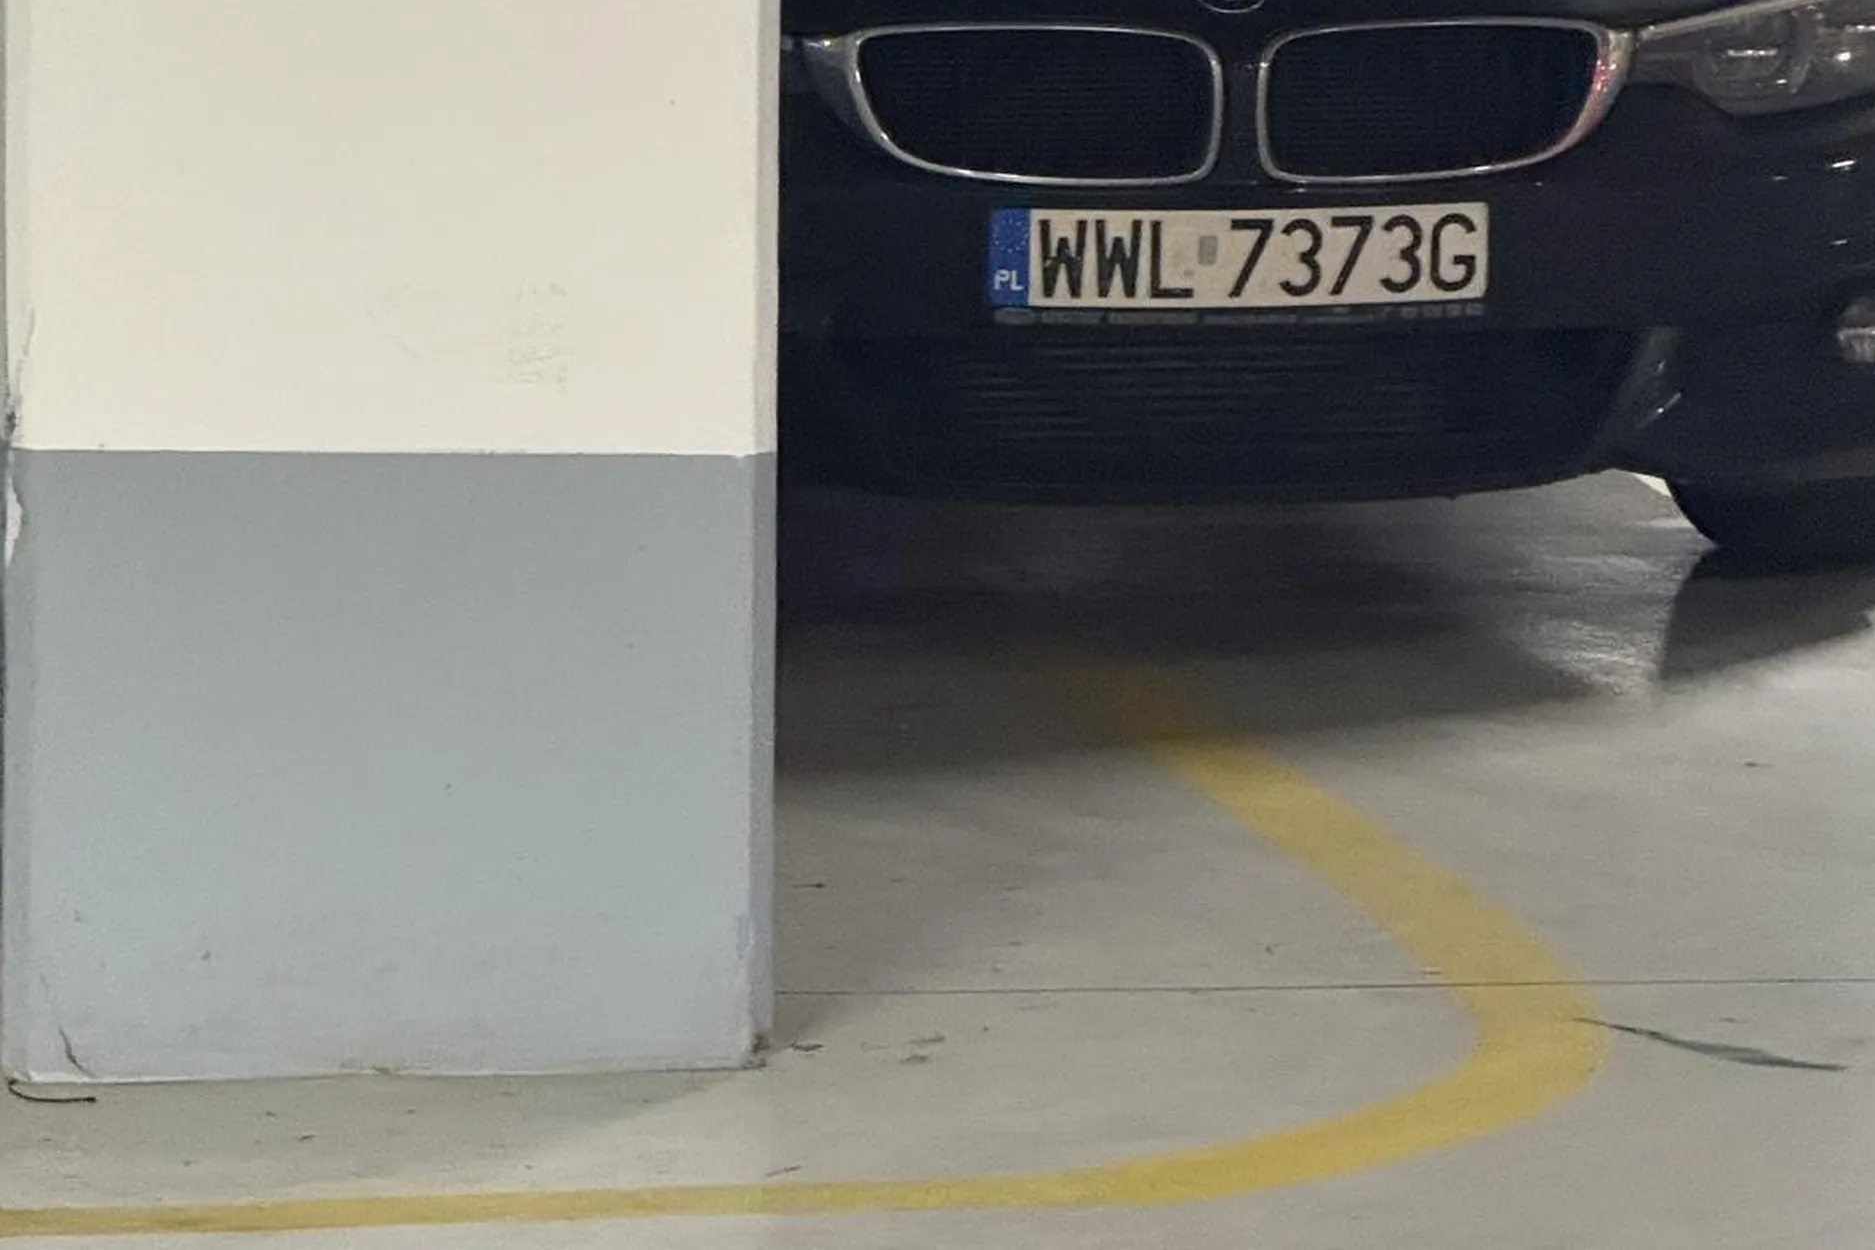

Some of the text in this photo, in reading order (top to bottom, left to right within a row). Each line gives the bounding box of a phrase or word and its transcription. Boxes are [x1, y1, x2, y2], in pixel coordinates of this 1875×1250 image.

[994, 269, 1025, 291] PL
[1039, 213, 1478, 298] WWL 7373G
